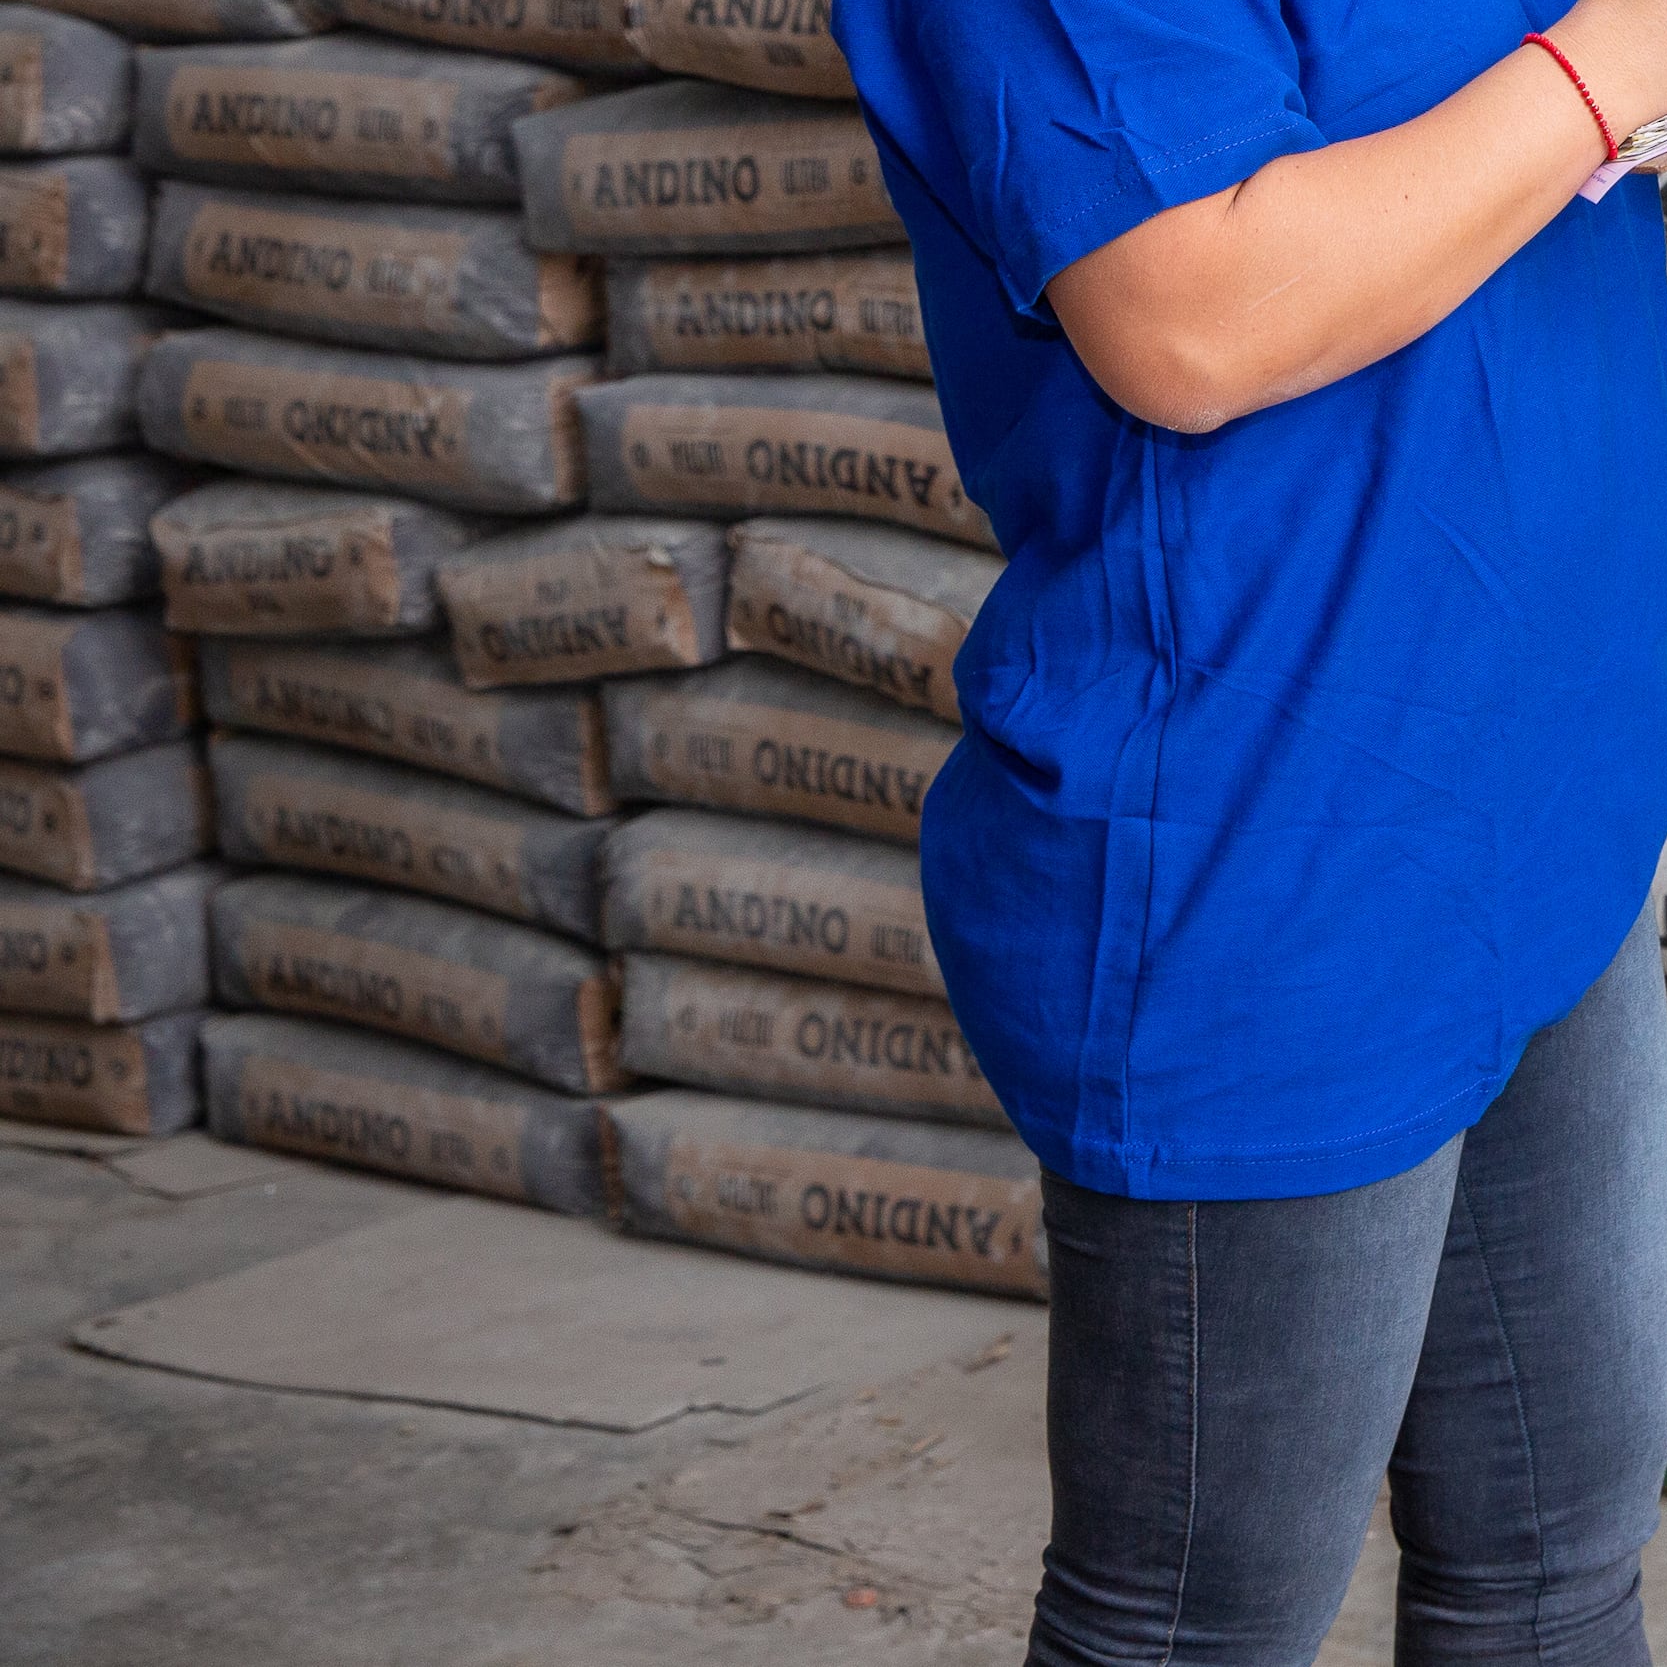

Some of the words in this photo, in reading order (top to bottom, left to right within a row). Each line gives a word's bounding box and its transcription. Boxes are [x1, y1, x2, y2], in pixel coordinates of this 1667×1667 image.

[593, 154, 760, 207] ANDINO
[672, 287, 835, 337] ANDINO
[745, 437, 938, 506] ANDINO
[672, 881, 848, 952] ANDINO
[800, 1184, 1002, 1256] ANDINO
